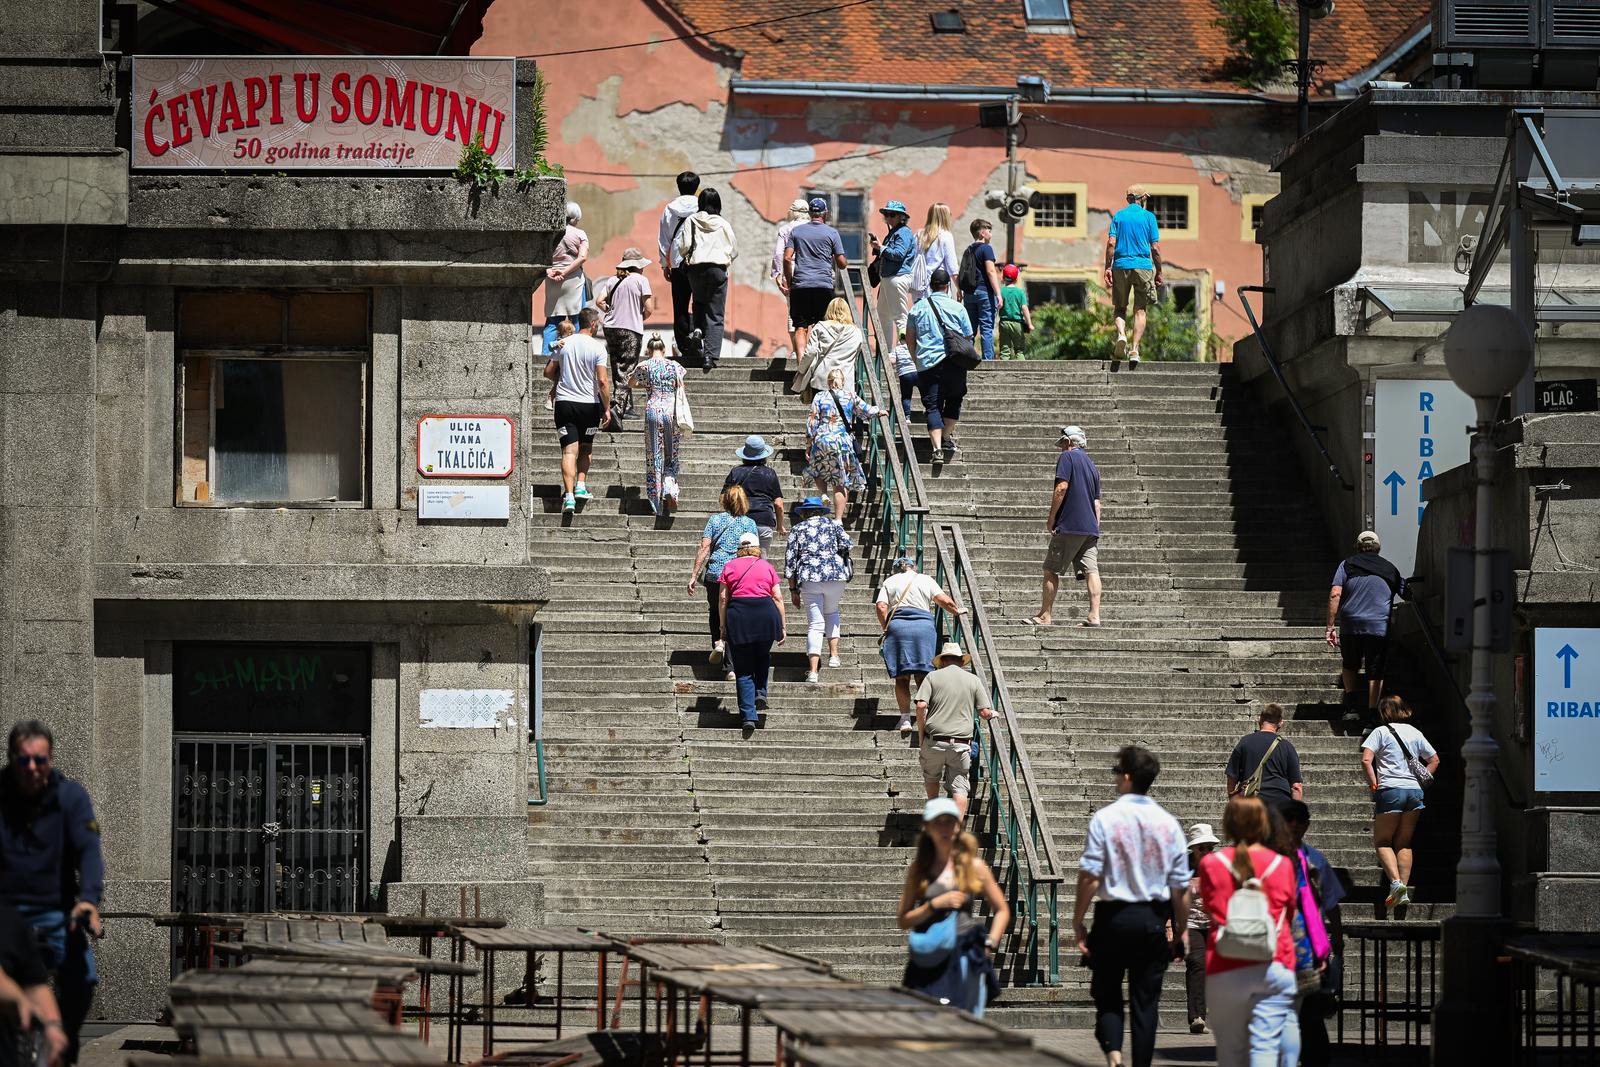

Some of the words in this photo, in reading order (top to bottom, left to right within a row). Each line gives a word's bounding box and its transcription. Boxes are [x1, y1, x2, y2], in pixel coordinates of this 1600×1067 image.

[144, 74, 283, 157] ĆEVAPI
[293, 73, 321, 123] U
[331, 73, 505, 156] SOMUNU
[234, 138, 261, 159] 50
[265, 142, 330, 164] godina
[337, 143, 415, 164] tradicije
[1543, 389, 1574, 407] PLAC
[450, 422, 482, 432] ULICA
[450, 435, 482, 444] IVANA
[437, 448, 494, 469] TKALČIĆA
